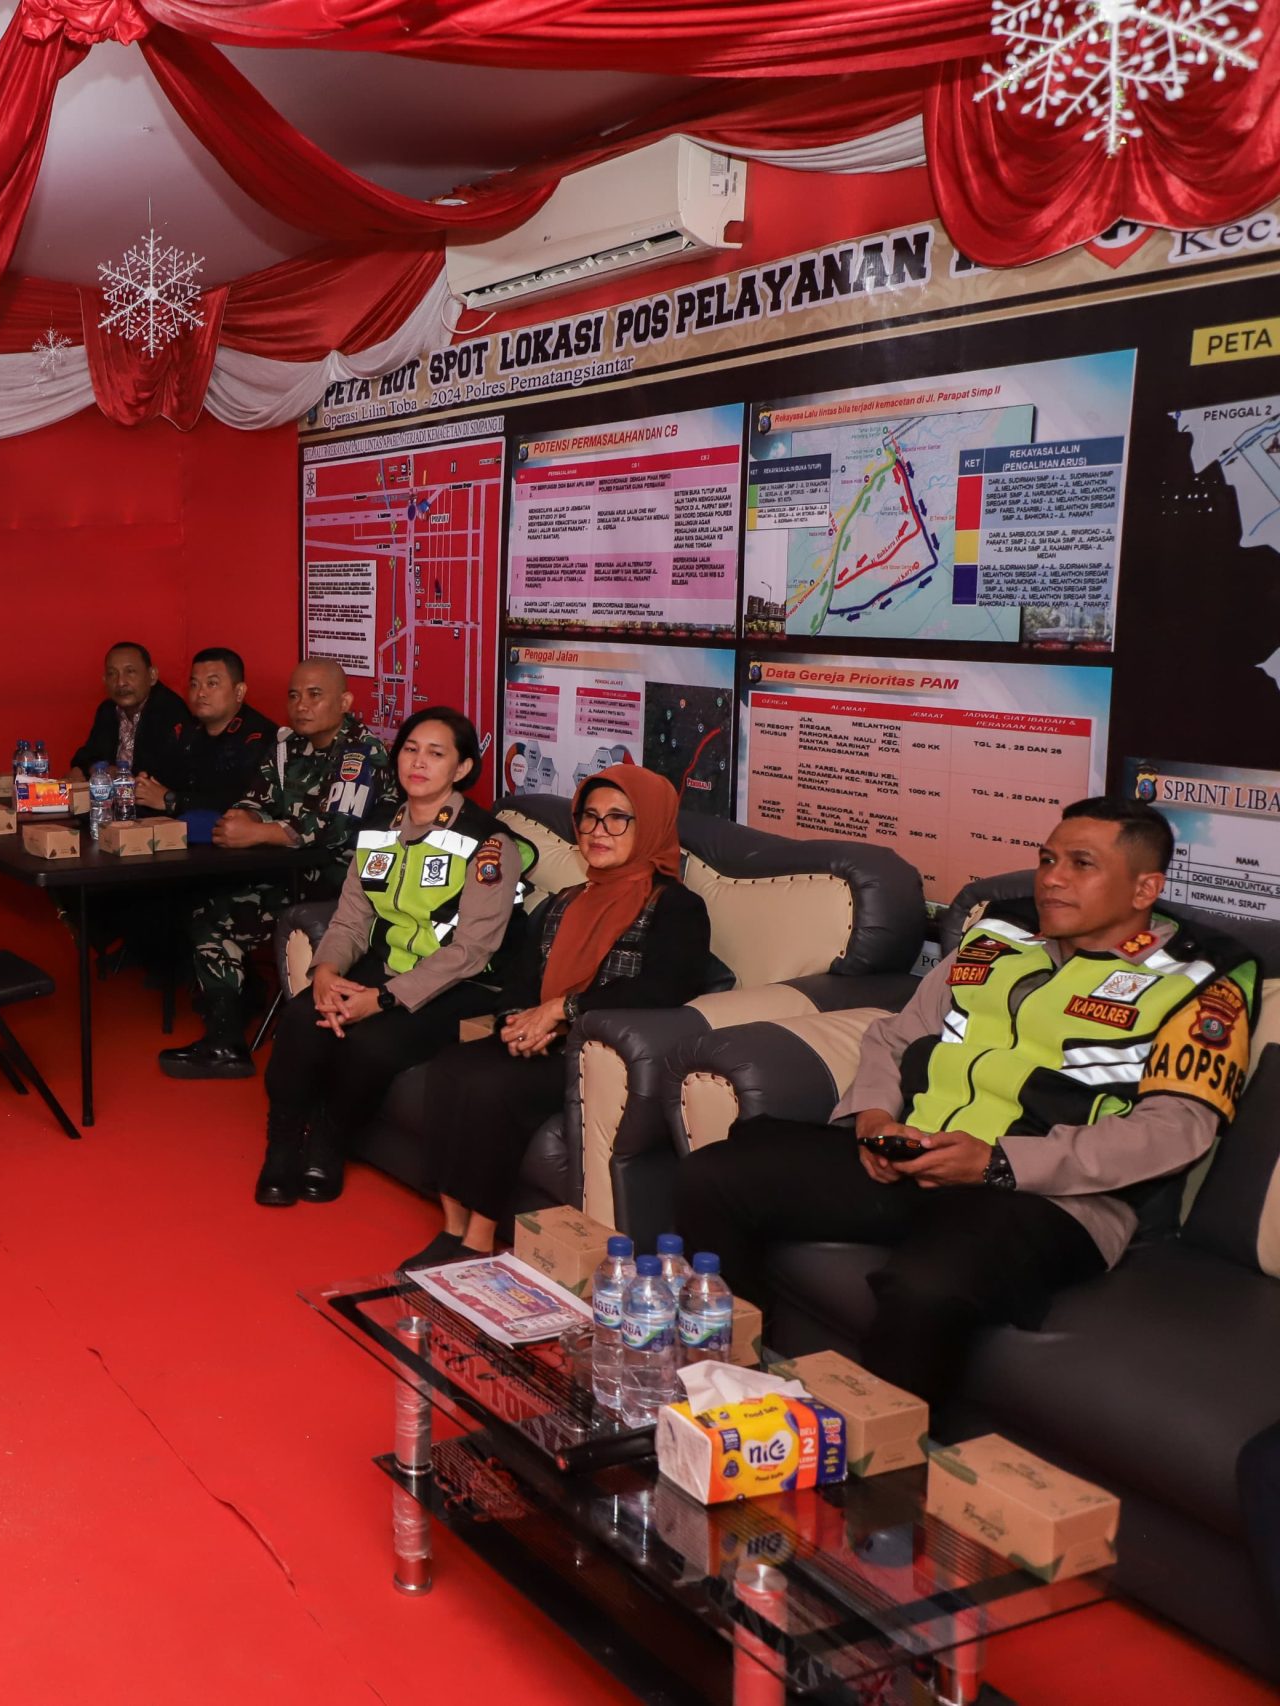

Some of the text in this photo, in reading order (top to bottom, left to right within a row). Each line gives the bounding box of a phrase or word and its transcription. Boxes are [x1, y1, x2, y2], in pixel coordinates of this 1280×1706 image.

[323, 378, 370, 408] PETA
[429, 341, 489, 385] SPOT
[501, 316, 606, 370] LOKASI
[616, 304, 672, 347] POS
[679, 232, 929, 332] PELAYANAN
[1208, 328, 1272, 355] PETA
[323, 358, 635, 428] Operasi Lilin Toba 2024 Polres Pematangsiantar
[775, 412, 804, 423] Rekayasa
[804, 410, 818, 419] Lalu
[838, 406, 850, 414] bila
[851, 402, 874, 413] terjadi
[875, 397, 915, 410] kemacetan
[916, 395, 925, 404] di
[937, 390, 970, 402] Parapat
[970, 387, 993, 398] Simp
[1203, 405, 1272, 421] PENGGAL 2
[533, 425, 678, 454] POTENSI PERMASALAHAN DAN CB
[1009, 445, 1080, 459] REKAYASA LALIN
[964, 459, 980, 468] KET
[1003, 457, 1087, 472] (PENGALIHAN ARUS)
[524, 648, 579, 663] Penggal Jalan
[766, 668, 959, 690] Data Gereja Prioritas PAM
[963, 711, 1000, 720] JADWAL
[766, 723, 794, 731] RESORT
[851, 721, 901, 731] MELANTHON
[976, 721, 1060, 733] PERAYAAN NATAL
[799, 730, 849, 741] PARHORASAN
[853, 736, 877, 744] NAULI
[974, 740, 991, 748] TGL
[798, 744, 870, 758] PEMATANGSIANTAR
[799, 737, 900, 754] SIANTAR MARIHAT KOTA
[752, 770, 793, 780] PARDAMEAN
[798, 770, 843, 780] PARDAMEAN
[865, 779, 899, 787] SIANTAR
[815, 765, 838, 773] FAREL
[840, 767, 879, 778] PASARIBU
[798, 776, 828, 785] MARIHAT
[797, 783, 868, 798] PEMATANGSIANTAR
[1164, 780, 1230, 806] SPRINT
[326, 781, 370, 818] PM
[1025, 795, 1046, 803] DAN
[870, 813, 898, 822] BAWAH
[796, 822, 867, 838] PEMATANGSIANTAR
[797, 815, 898, 837] SIANTAR MARIHAT KOTA
[971, 832, 988, 840] TGL
[1023, 840, 1043, 848] DAN
[1176, 848, 1188, 857] NO
[1236, 856, 1260, 867] NAMA
[1192, 873, 1273, 895] DONI SIMANJUNTAK,
[1175, 889, 1183, 897] 2.
[1239, 899, 1267, 911] SIRAIT
[1071, 999, 1130, 1024] KAPOLRES
[622, 1320, 642, 1337] QUA
[803, 1437, 815, 1454] 2
